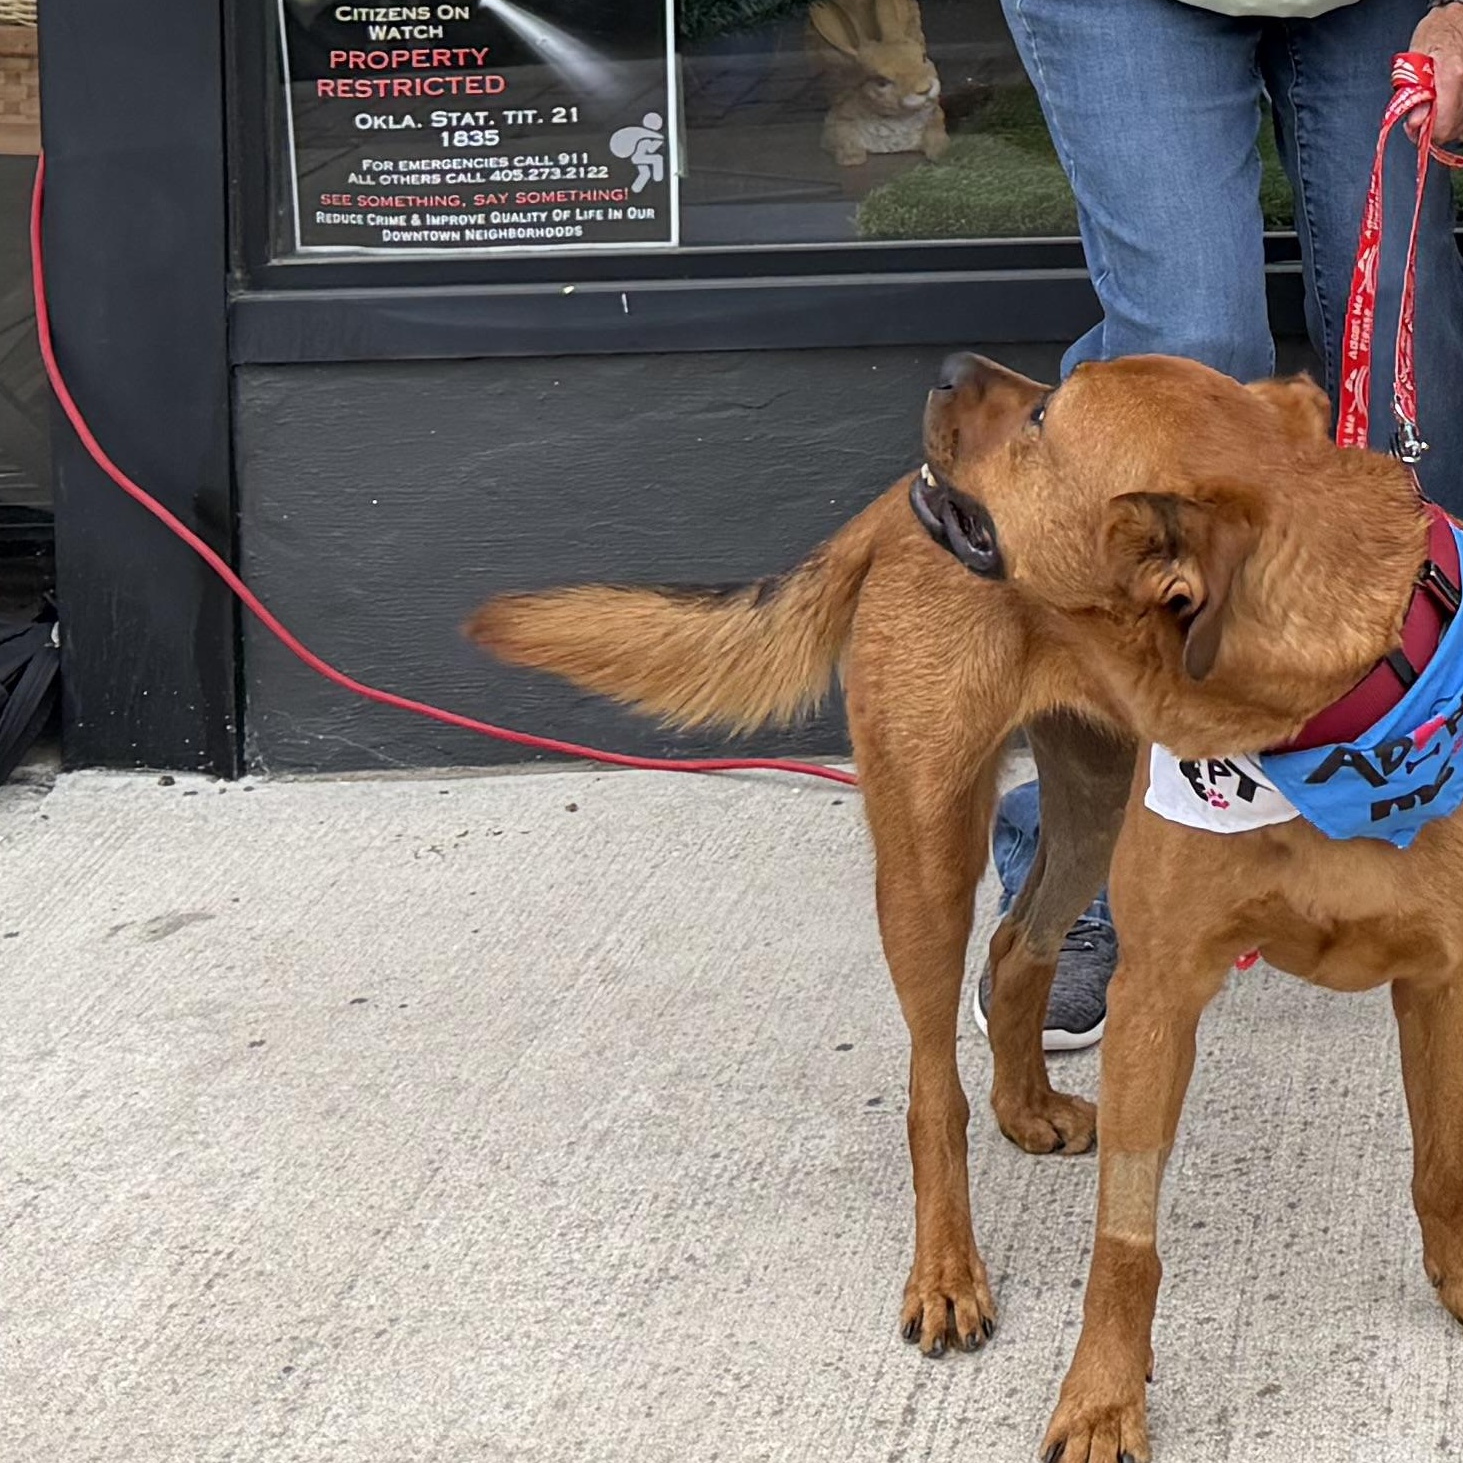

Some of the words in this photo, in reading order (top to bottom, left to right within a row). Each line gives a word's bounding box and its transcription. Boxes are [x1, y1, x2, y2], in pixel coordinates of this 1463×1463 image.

[335, 6, 431, 22] CITIZENS
[437, 5, 470, 20] ON
[368, 25, 443, 41] WATCH
[329, 47, 490, 70] PROPERTY
[317, 75, 506, 98] RESTRICTED
[354, 112, 423, 130] OKLA.
[431, 110, 495, 128] STAT.
[502, 110, 544, 125] TIT.
[551, 107, 579, 123] 21
[440, 130, 500, 147] 1835
[361, 159, 394, 172] FOR
[399, 156, 509, 172] EMERGENCIES
[513, 155, 553, 167] CALL
[558, 153, 589, 165] 911
[348, 173, 375, 185] ALL
[379, 174, 441, 185] OTHERS
[445, 173, 485, 184] CALL
[489, 166, 609, 183] 405.273.2122
[320, 194, 352, 206] SEE
[357, 194, 467, 208] SOMETHING,
[473, 192, 509, 206] SAY
[515, 188, 629, 204] SOMETHING!
[410, 213, 422, 226] &
[382, 229, 461, 242] DOWNTOWN
[465, 225, 583, 241] NEIGHBORHOODS
